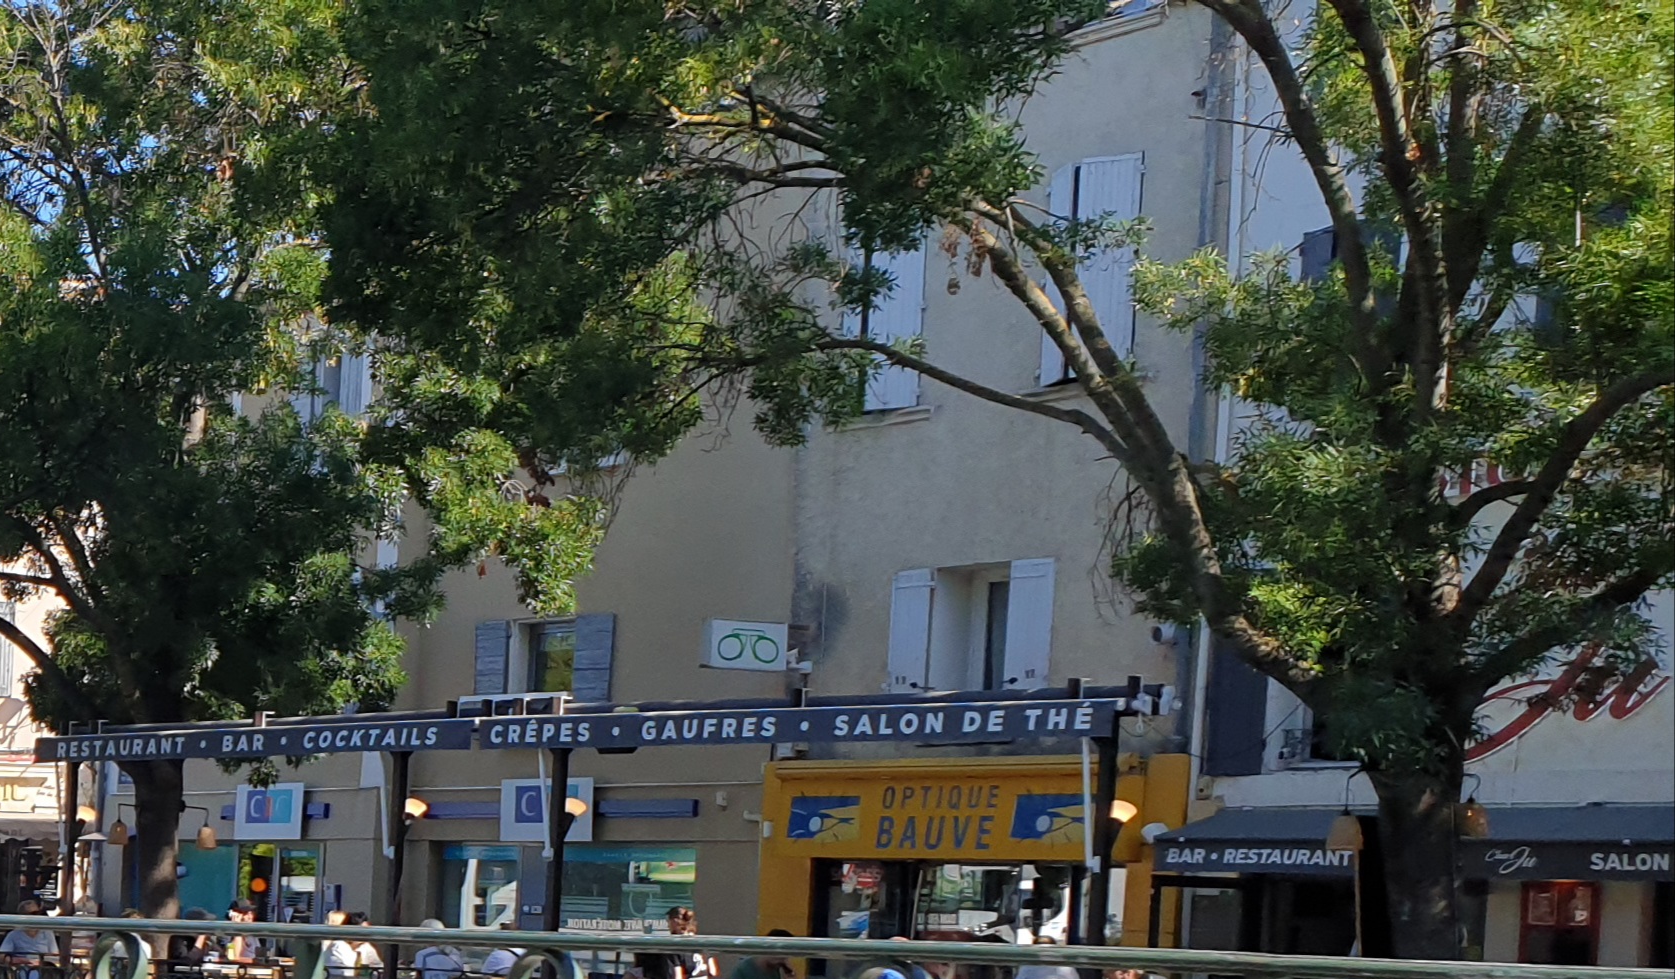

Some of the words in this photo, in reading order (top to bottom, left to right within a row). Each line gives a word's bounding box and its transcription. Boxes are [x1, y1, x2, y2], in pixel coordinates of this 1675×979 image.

[56, 736, 185, 759] RESTAURANT
[222, 733, 264, 752] BAR
[303, 726, 438, 749] COCKTAILS
[489, 718, 591, 743] CRÊPES
[641, 716, 777, 741] GAUFRES
[833, 711, 944, 736] SALON
[962, 709, 1006, 732] DE
[1024, 702, 1094, 731] THÉ
[882, 785, 1000, 810] OPTIQUE
[876, 815, 995, 850] BAUVE
[1166, 848, 1205, 864] BAR
[1223, 848, 1353, 867] RESTAURANT
[1589, 852, 1670, 871] SALON
